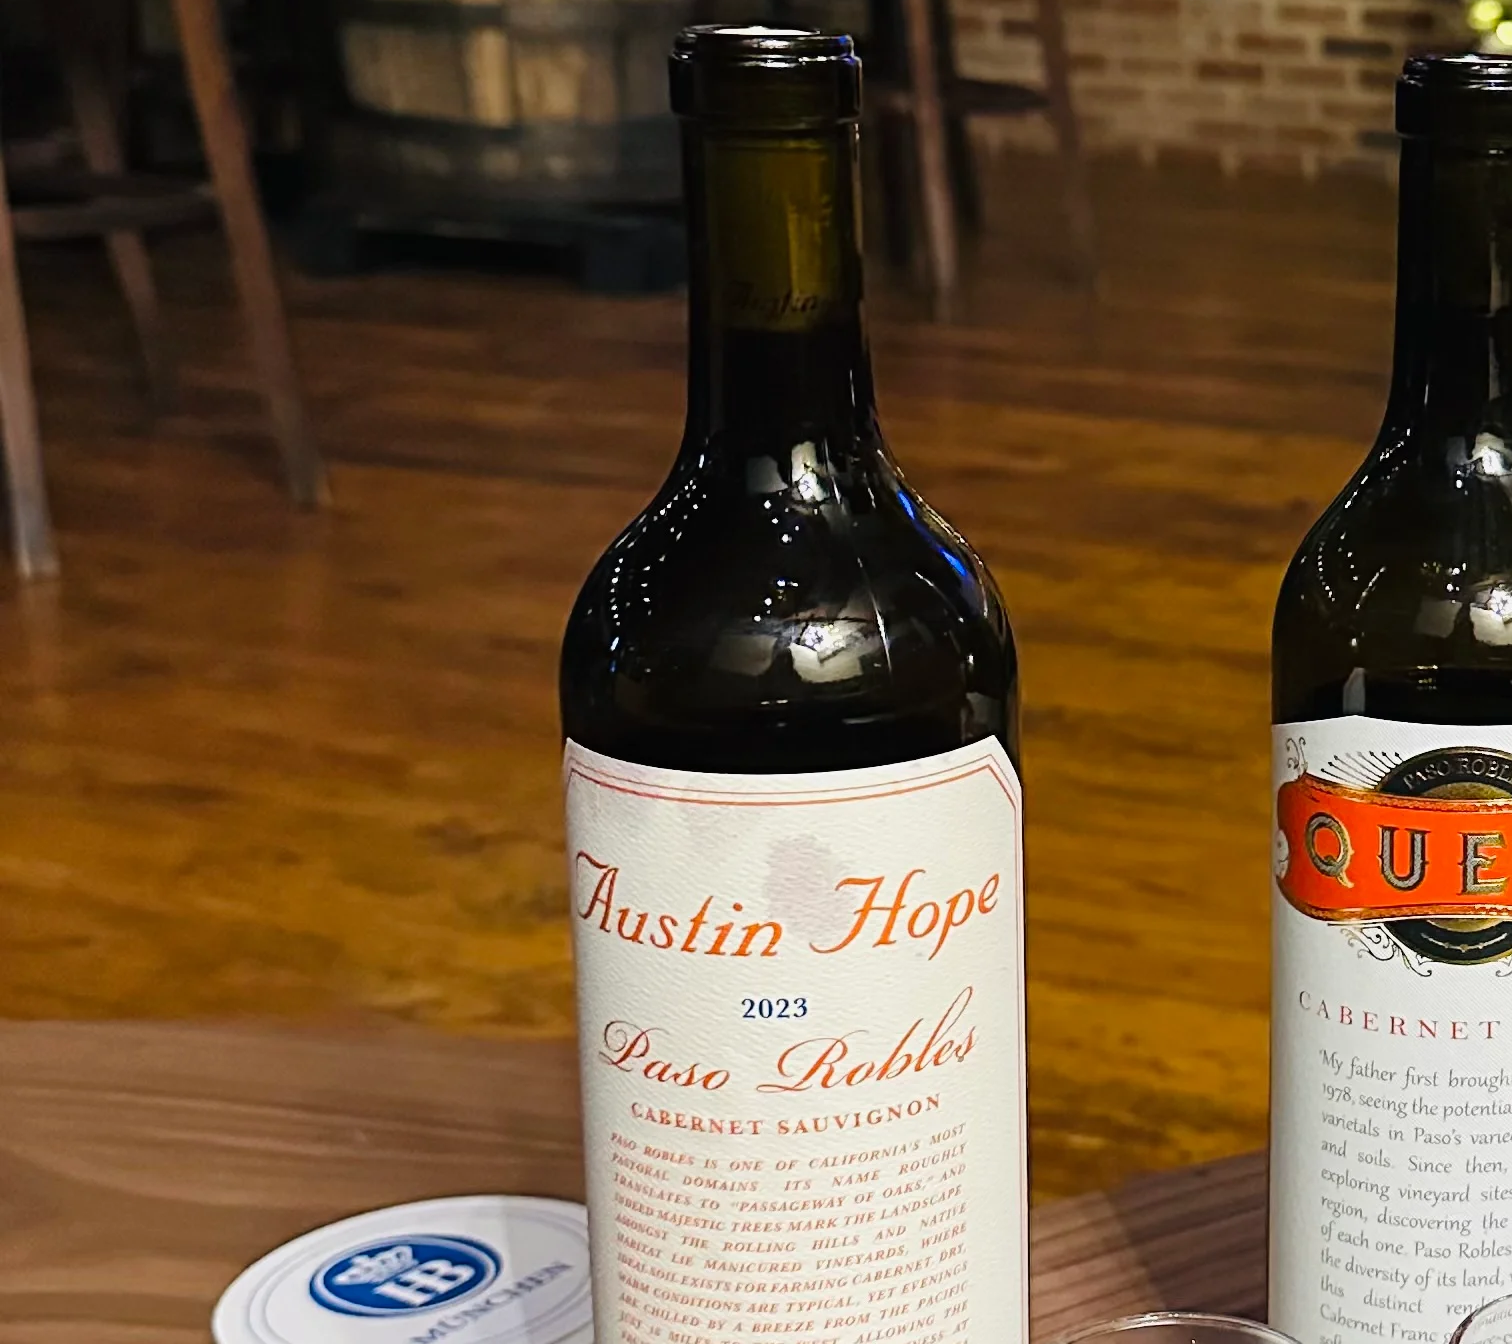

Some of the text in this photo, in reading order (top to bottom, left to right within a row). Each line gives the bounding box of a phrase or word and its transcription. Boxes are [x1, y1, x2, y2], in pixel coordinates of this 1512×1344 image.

[1402, 759, 1452, 790] PASO
[575, 850, 1000, 961] Austin Hope
[742, 997, 809, 1019] 2023
[1299, 989, 1501, 1040] CABERNET
[600, 985, 976, 1093] Paso Robles
[1347, 1056, 1397, 1084] father
[1401, 1067, 1439, 1091] first
[631, 1093, 941, 1135] CABERNET SAUVIGNON
[1358, 1093, 1408, 1119] seeing
[1413, 1100, 1439, 1117] the
[643, 1122, 966, 1171] ROBLES IS ONE OF CALIFORNIA'S MOST
[1321, 1112, 1380, 1137] varietals
[1388, 1124, 1404, 1141] in
[1414, 1126, 1462, 1145] Paso's
[683, 1142, 968, 1192] DOMAINS ITS NAME ROUGHLY
[1321, 1139, 1347, 1157] and
[1408, 1155, 1453, 1173] Since
[1465, 1156, 1508, 1174] then,
[613, 1164, 967, 1210] TRANSLATES TO OF AND
[657, 1184, 962, 1232] MAJESTIC TREES MARK THE LANDSCAPE
[1321, 1167, 1390, 1201] exploring
[1398, 1186, 1470, 1207] vineyard
[681, 1202, 968, 1253] THE ROLLING HILLS AND NATIVE
[1321, 1195, 1368, 1224] region,
[1377, 1211, 1472, 1237] discovering
[1482, 1214, 1508, 1229] the
[672, 1222, 968, 1273] LIE MANICURED VINEYARDS, WHERE
[1320, 1223, 1336, 1244] of
[1337, 1229, 1369, 1250] each
[1414, 1241, 1452, 1259] Paso
[1459, 1240, 1512, 1259] Robles
[372, 1258, 476, 1308] HB
[650, 1256, 933, 1294] SOIL EXISTS FOR FARMING CABERNET
[653, 1261, 969, 1313] CONDITIONS ARE YET EVENINGS
[1320, 1247, 1342, 1270] the
[1345, 1256, 1410, 1289] diversity
[1414, 1267, 1432, 1291] of
[1437, 1270, 1457, 1286] its
[1462, 1268, 1504, 1288] land,
[643, 1281, 968, 1333] CHILLED BY A BREEZE FROM THE PACIFIC
[943, 1299, 969, 1319] THE
[1320, 1274, 1424, 1314] this distinct
[952, 1318, 970, 1335] AT
[1320, 1303, 1438, 1343] Cabernet Franc
